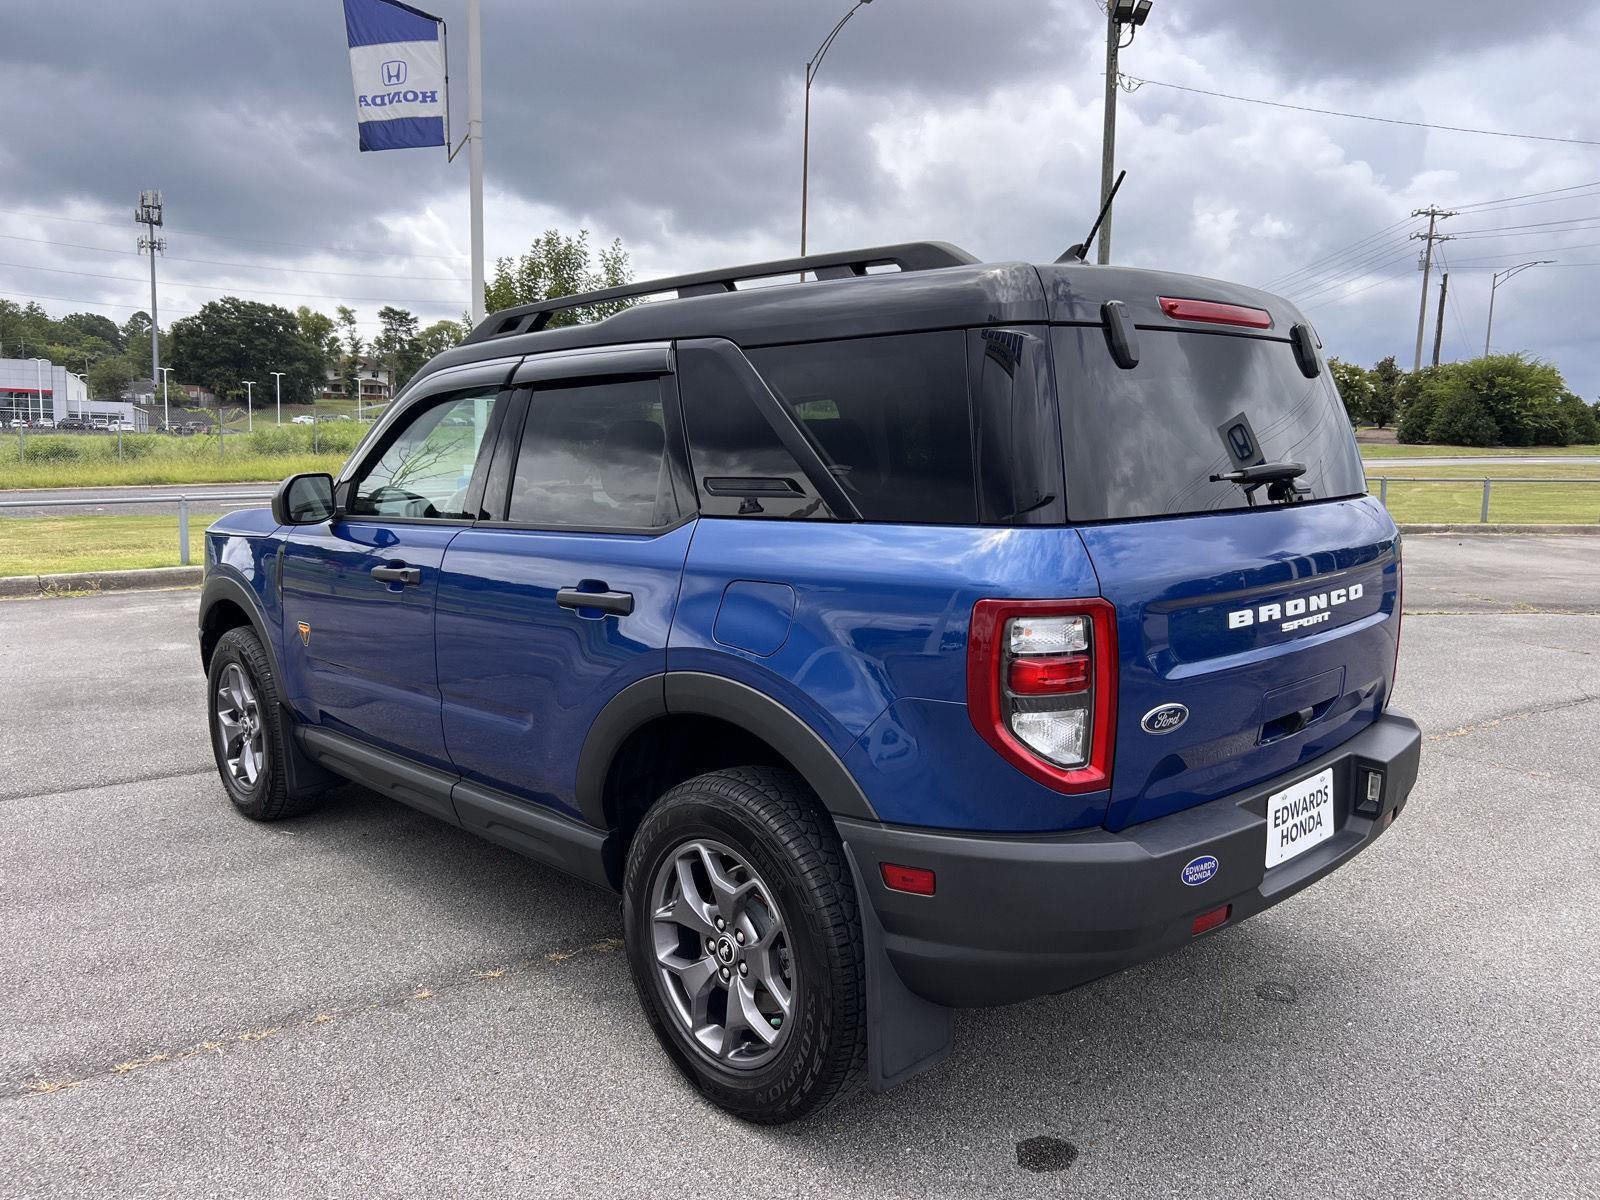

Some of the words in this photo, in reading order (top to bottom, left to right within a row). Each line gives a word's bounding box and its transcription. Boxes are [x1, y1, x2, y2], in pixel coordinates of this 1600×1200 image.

[1228, 583, 1363, 629] BRONCO
[1281, 611, 1331, 632] SPORT
[1154, 709, 1181, 728] Ford
[1274, 785, 1329, 828] EDWARDS
[1280, 811, 1323, 847] HONDA
[1185, 860, 1216, 876] EDWARDS
[1188, 869, 1211, 883] HONDA
